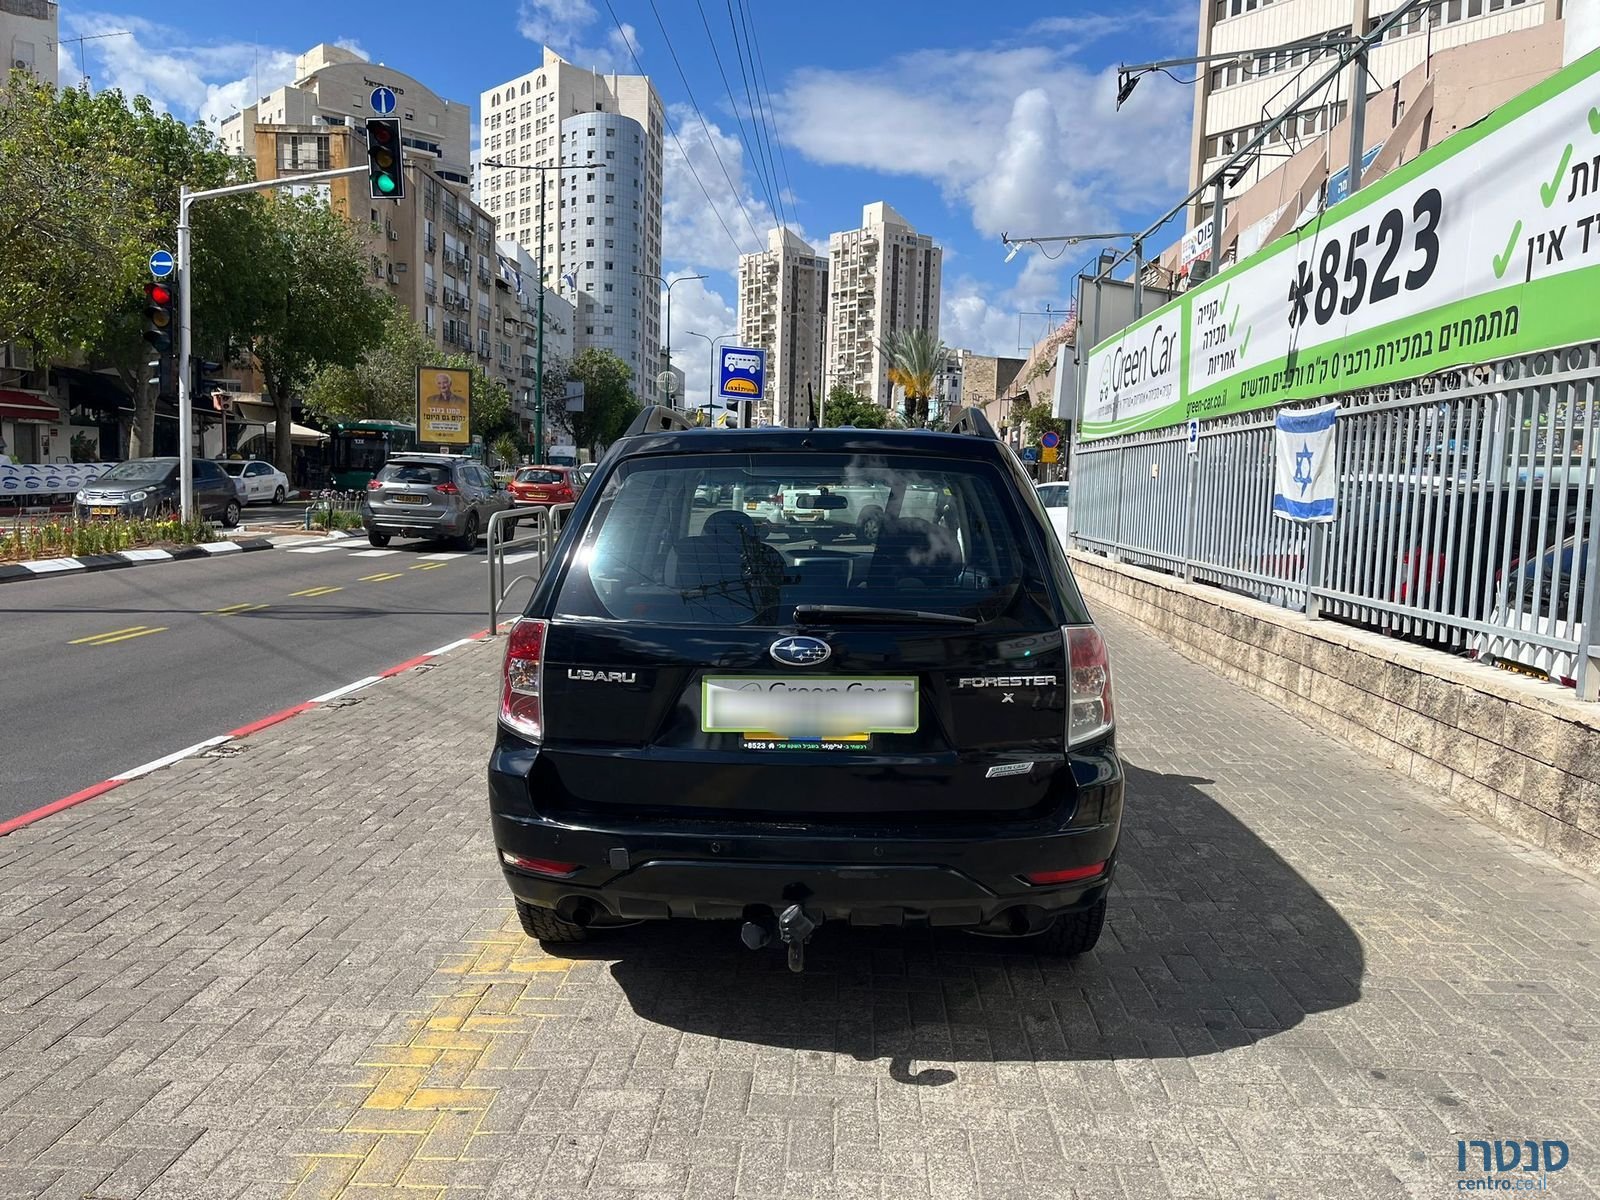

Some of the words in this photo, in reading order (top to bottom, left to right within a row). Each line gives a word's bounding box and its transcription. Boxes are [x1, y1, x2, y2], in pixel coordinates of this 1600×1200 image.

[1526, 225, 1568, 283] אין
[1197, 299, 1219, 325] קנייה
[1203, 323, 1227, 350] מכירה
[1438, 305, 1519, 352] מתמחים
[1112, 345, 1147, 393] Green
[1150, 324, 1177, 378] Car
[1207, 348, 1237, 376] אחריות
[1343, 348, 1371, 376] רכבי
[1373, 330, 1433, 369] במכירת
[1240, 375, 1270, 399] חדשים
[1186, 389, 1228, 419] green-car.co.il
[958, 675, 1057, 688] FORESTER
[1001, 692, 1014, 703] X
